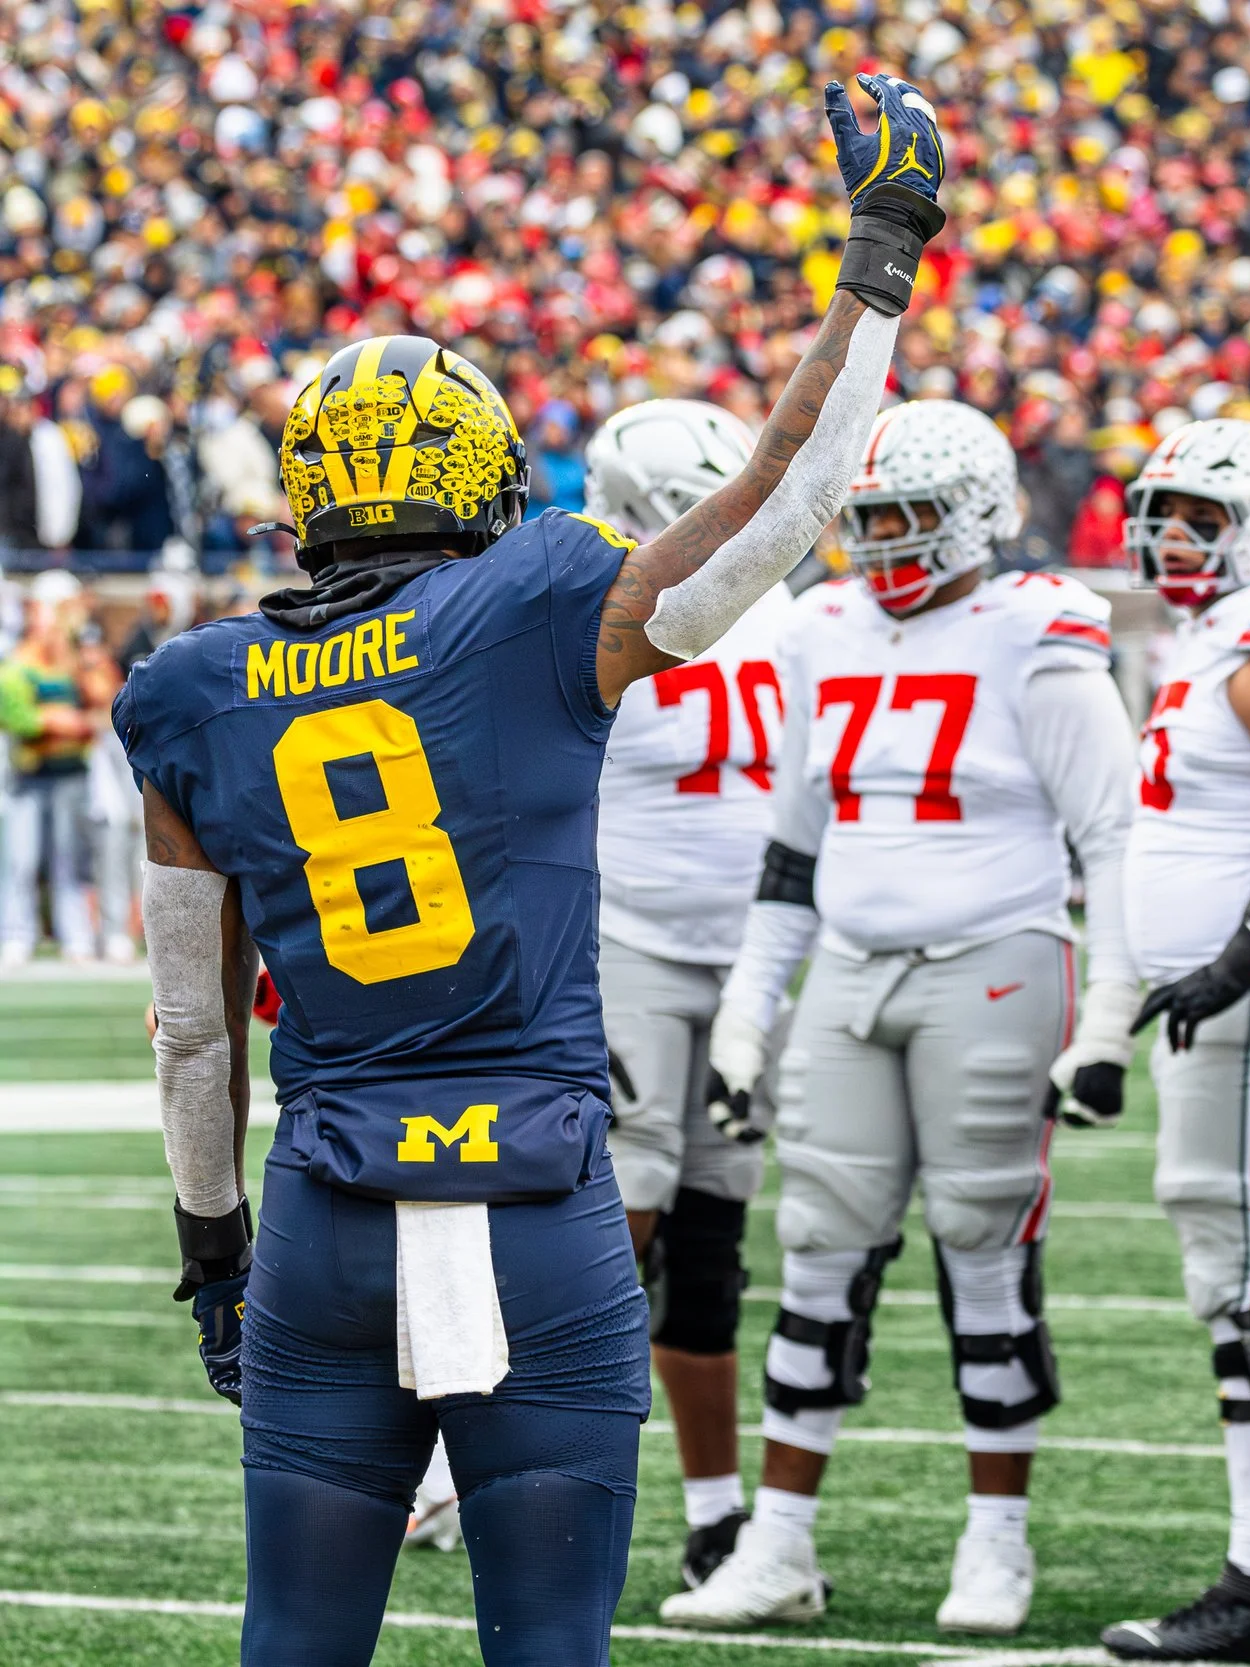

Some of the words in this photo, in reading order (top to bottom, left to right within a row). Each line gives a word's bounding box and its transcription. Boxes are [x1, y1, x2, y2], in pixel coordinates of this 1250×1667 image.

[353, 434, 373, 442] GAME
[246, 609, 419, 699] MOORE
[815, 673, 978, 823] 77
[272, 698, 476, 985] 8
[397, 1103, 499, 1163] M
